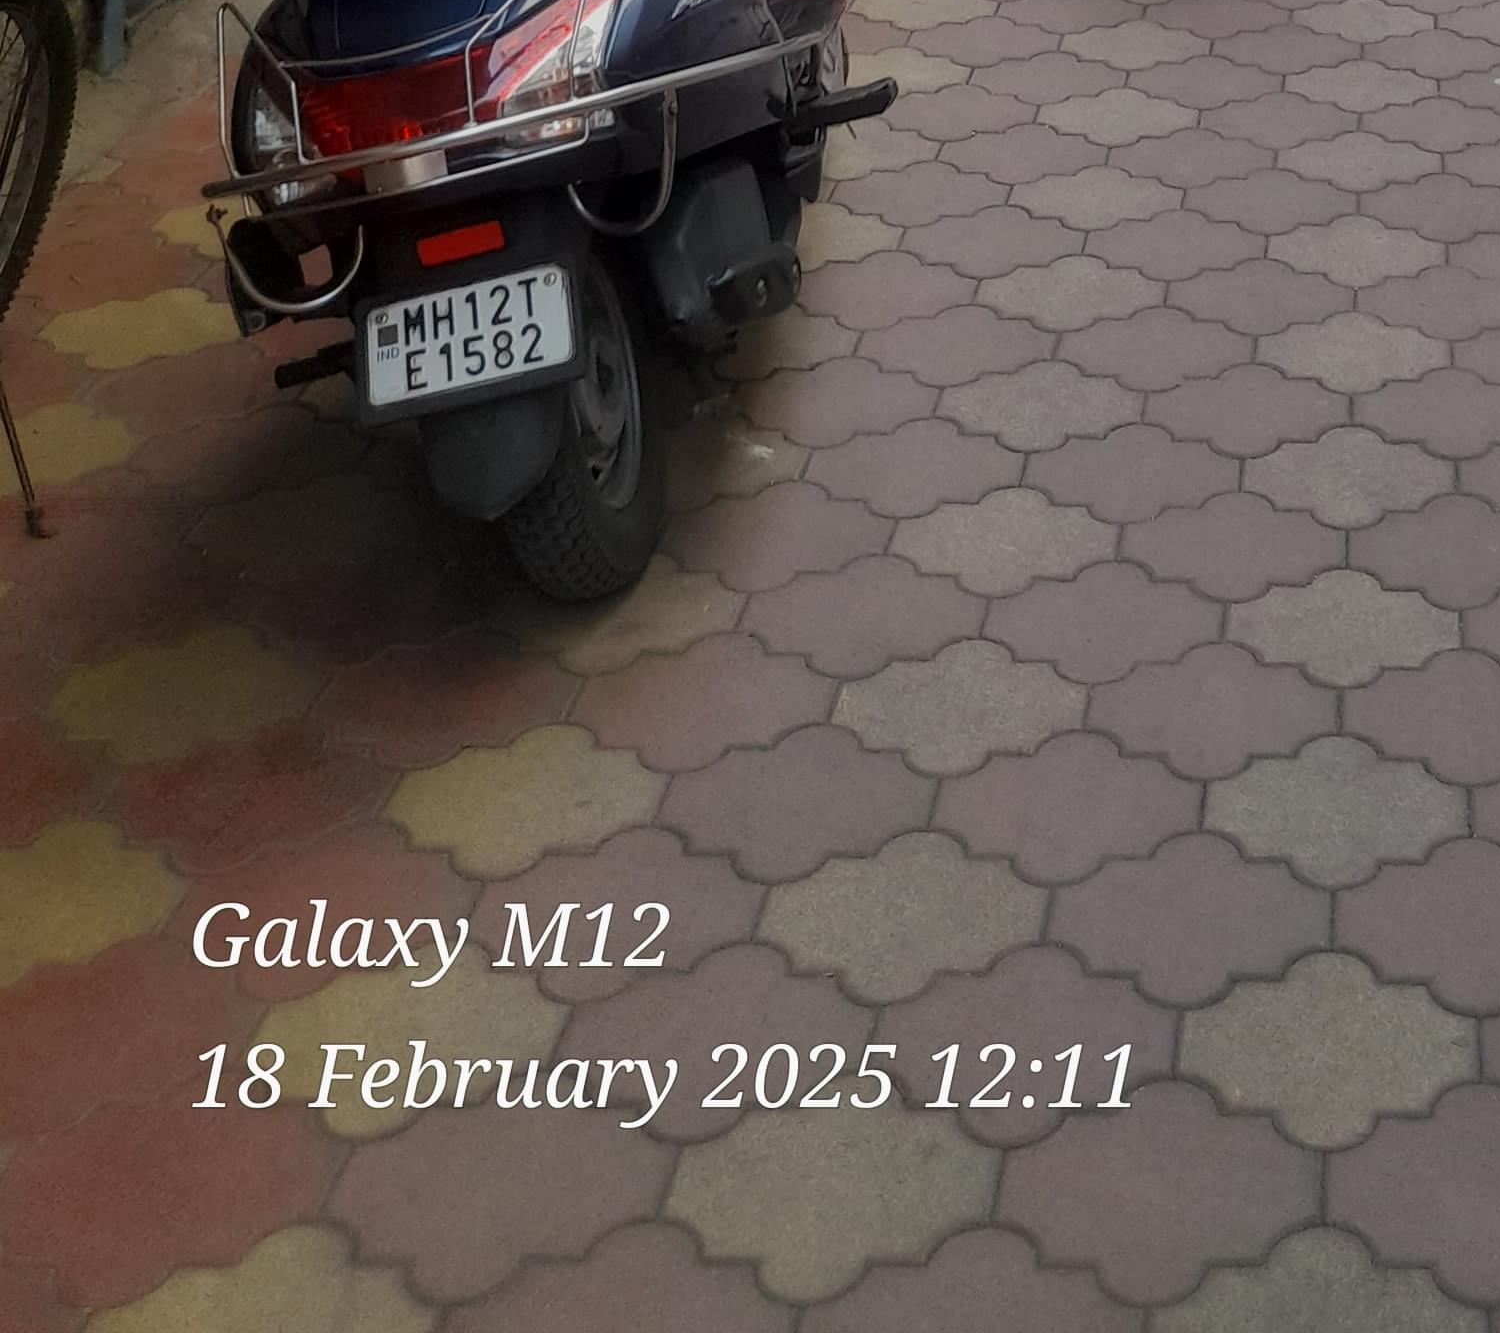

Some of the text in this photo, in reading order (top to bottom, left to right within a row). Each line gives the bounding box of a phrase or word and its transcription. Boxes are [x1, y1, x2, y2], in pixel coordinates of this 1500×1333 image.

[403, 277, 537, 346] MH12T
[377, 347, 400, 363] IND
[406, 323, 543, 391] E1582
